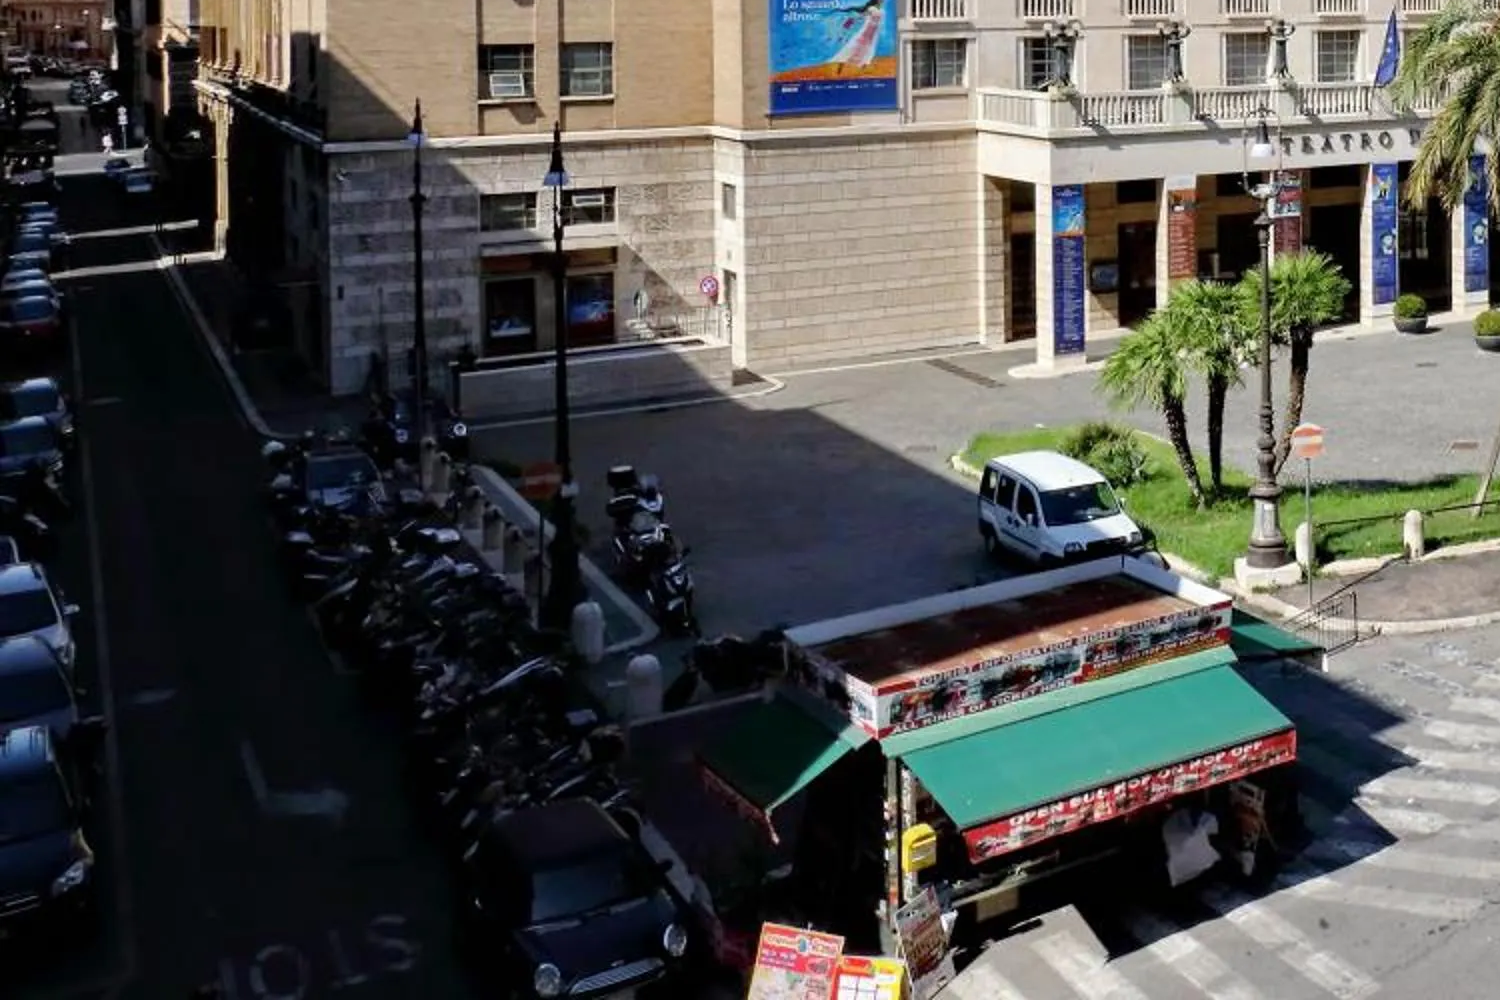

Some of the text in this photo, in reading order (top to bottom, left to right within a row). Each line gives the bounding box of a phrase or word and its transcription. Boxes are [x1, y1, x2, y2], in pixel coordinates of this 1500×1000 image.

[1280, 131, 1395, 156] TEATRO
[968, 701, 987, 713] OF
[1009, 801, 1066, 826] OPEN
[1113, 775, 1153, 796] HOP
[1157, 767, 1185, 780] ON
[1189, 751, 1227, 770] HOP
[1231, 740, 1264, 757] OFF
